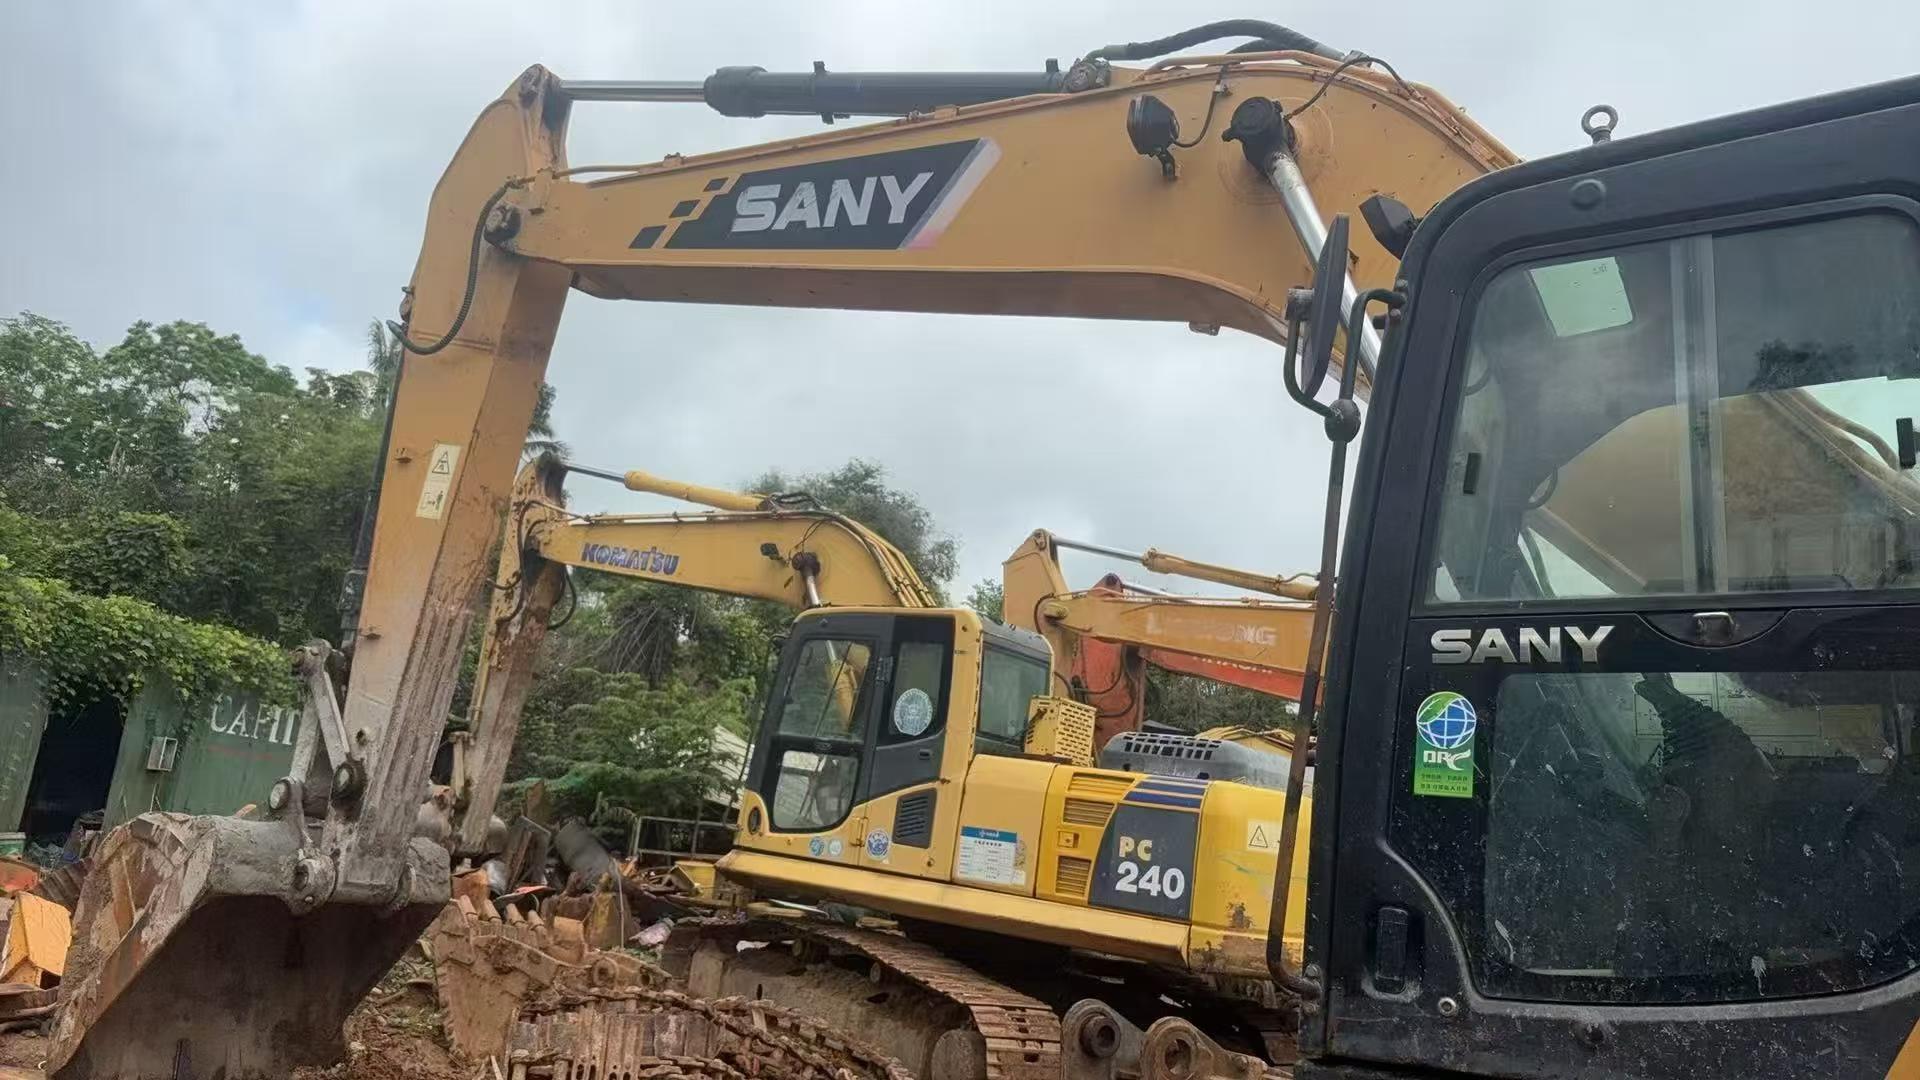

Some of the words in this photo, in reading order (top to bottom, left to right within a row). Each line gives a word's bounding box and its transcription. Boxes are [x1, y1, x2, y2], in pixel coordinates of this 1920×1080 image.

[731, 171, 934, 232] SANY
[581, 543, 680, 575] KOMATSU
[1431, 625, 1615, 663] SANY
[1118, 836, 1153, 861] PC
[1115, 861, 1185, 900] 240
